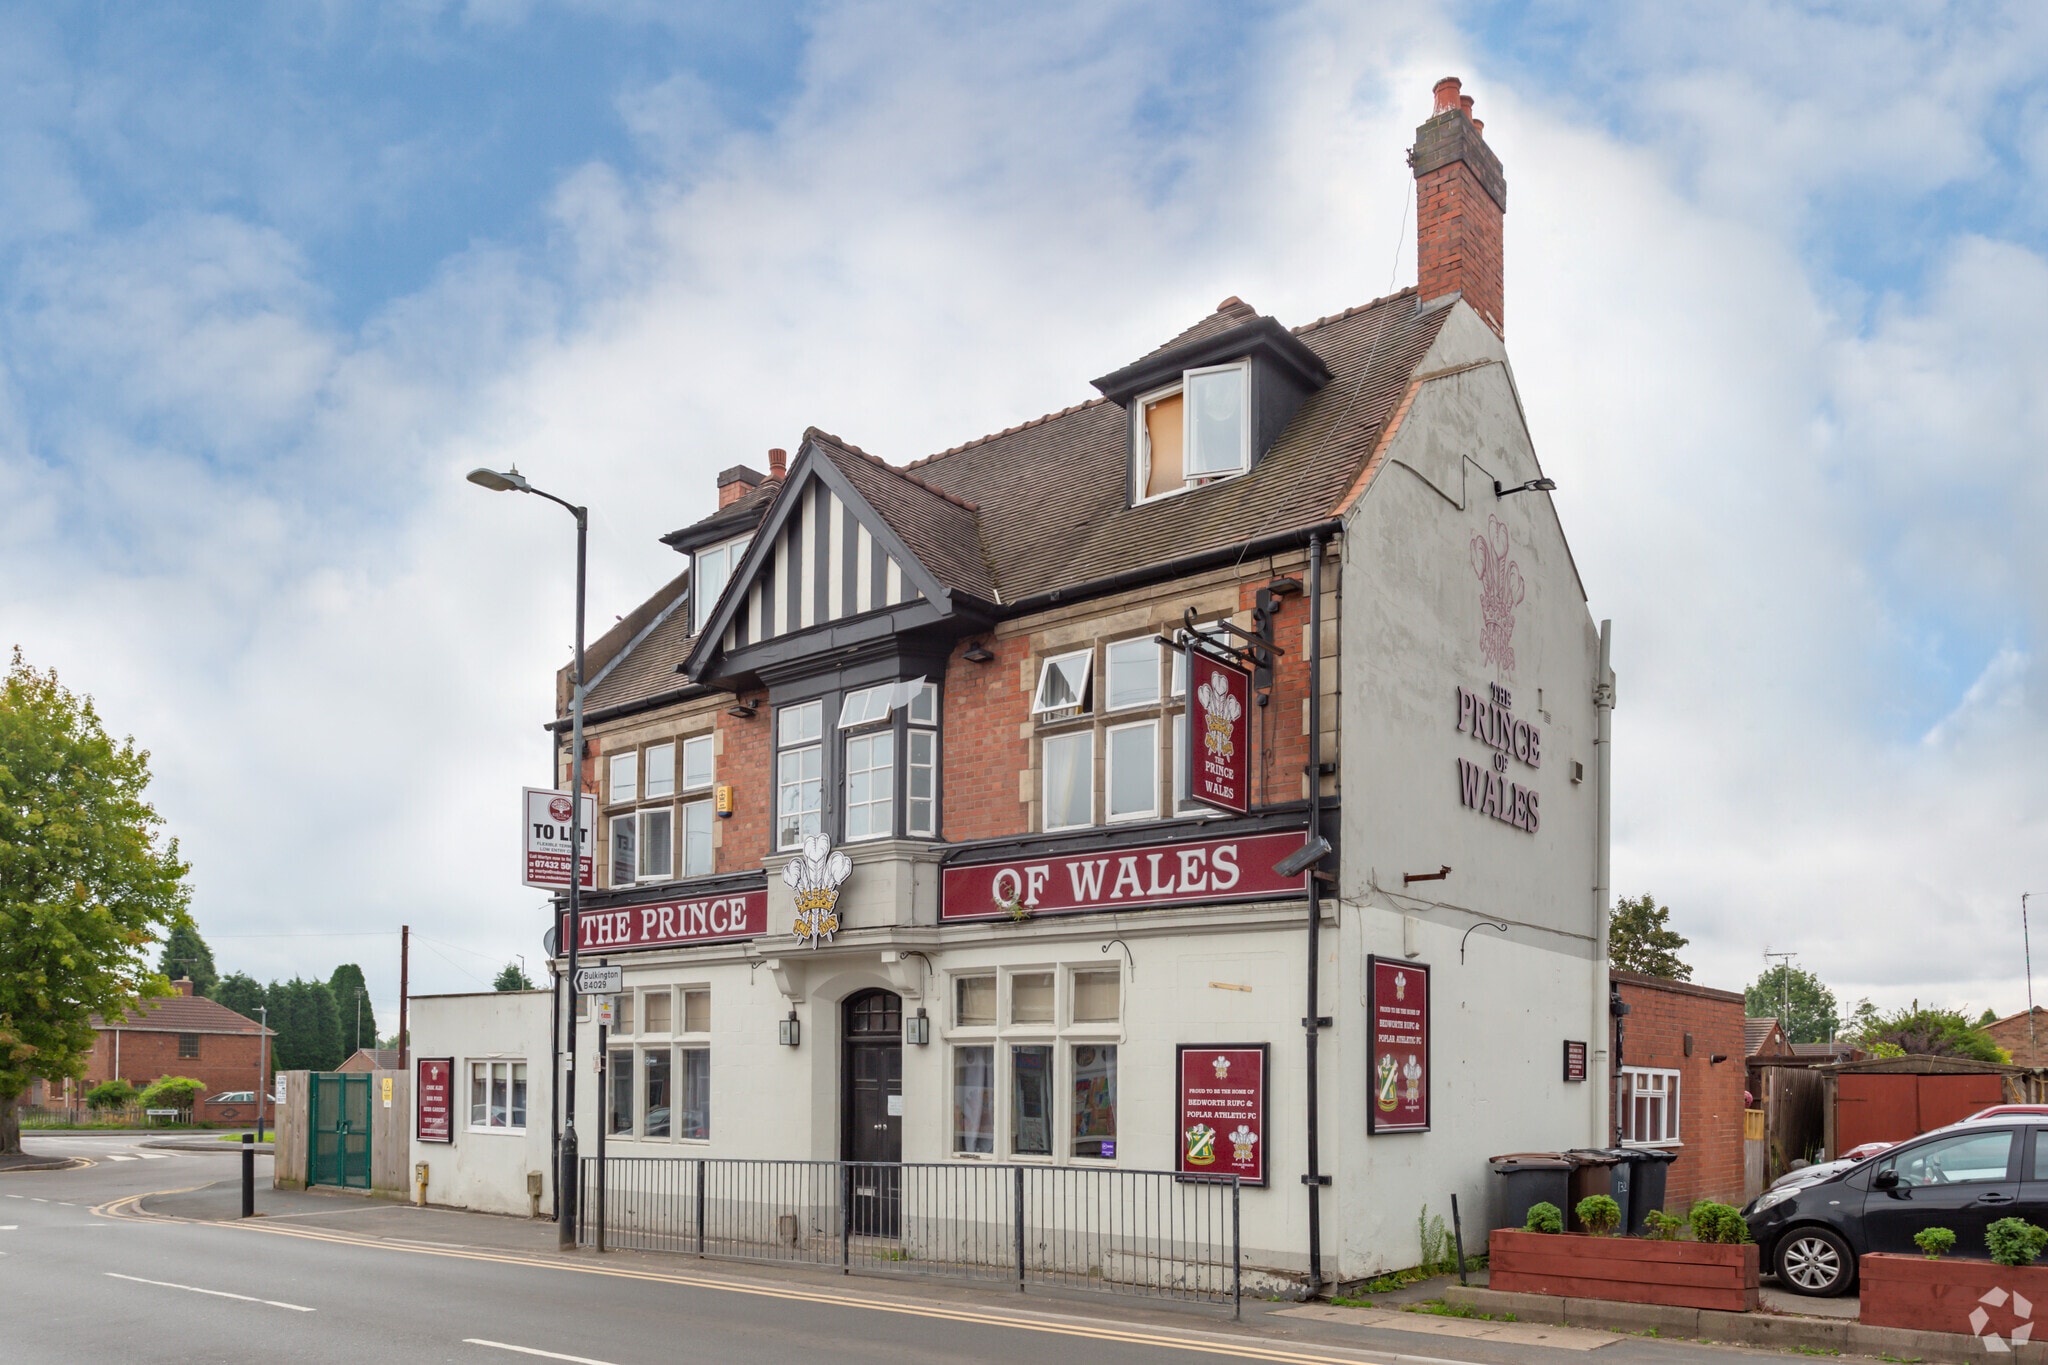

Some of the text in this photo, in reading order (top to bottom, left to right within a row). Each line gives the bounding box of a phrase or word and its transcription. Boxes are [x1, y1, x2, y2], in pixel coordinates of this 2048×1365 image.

[1490, 681, 1512, 709] THE
[1457, 685, 1541, 769] PRINCE
[1205, 760, 1234, 780] PRINCE
[1214, 756, 1225, 765] THE
[1493, 751, 1508, 774] OF
[1205, 780, 1234, 799] WALES
[1457, 757, 1541, 834] WALES
[533, 823, 588, 843] TO LT
[535, 860, 588, 872] 07432 5030
[991, 844, 1240, 908] OF WALES
[580, 897, 747, 946] THE PRINCE
[584, 971, 619, 980] Bulkington
[584, 980, 607, 990] B4029
[1379, 1019, 1403, 1028] BEDWORTH
[1379, 1034, 1422, 1044] POPLAR ATHLETIC FC
